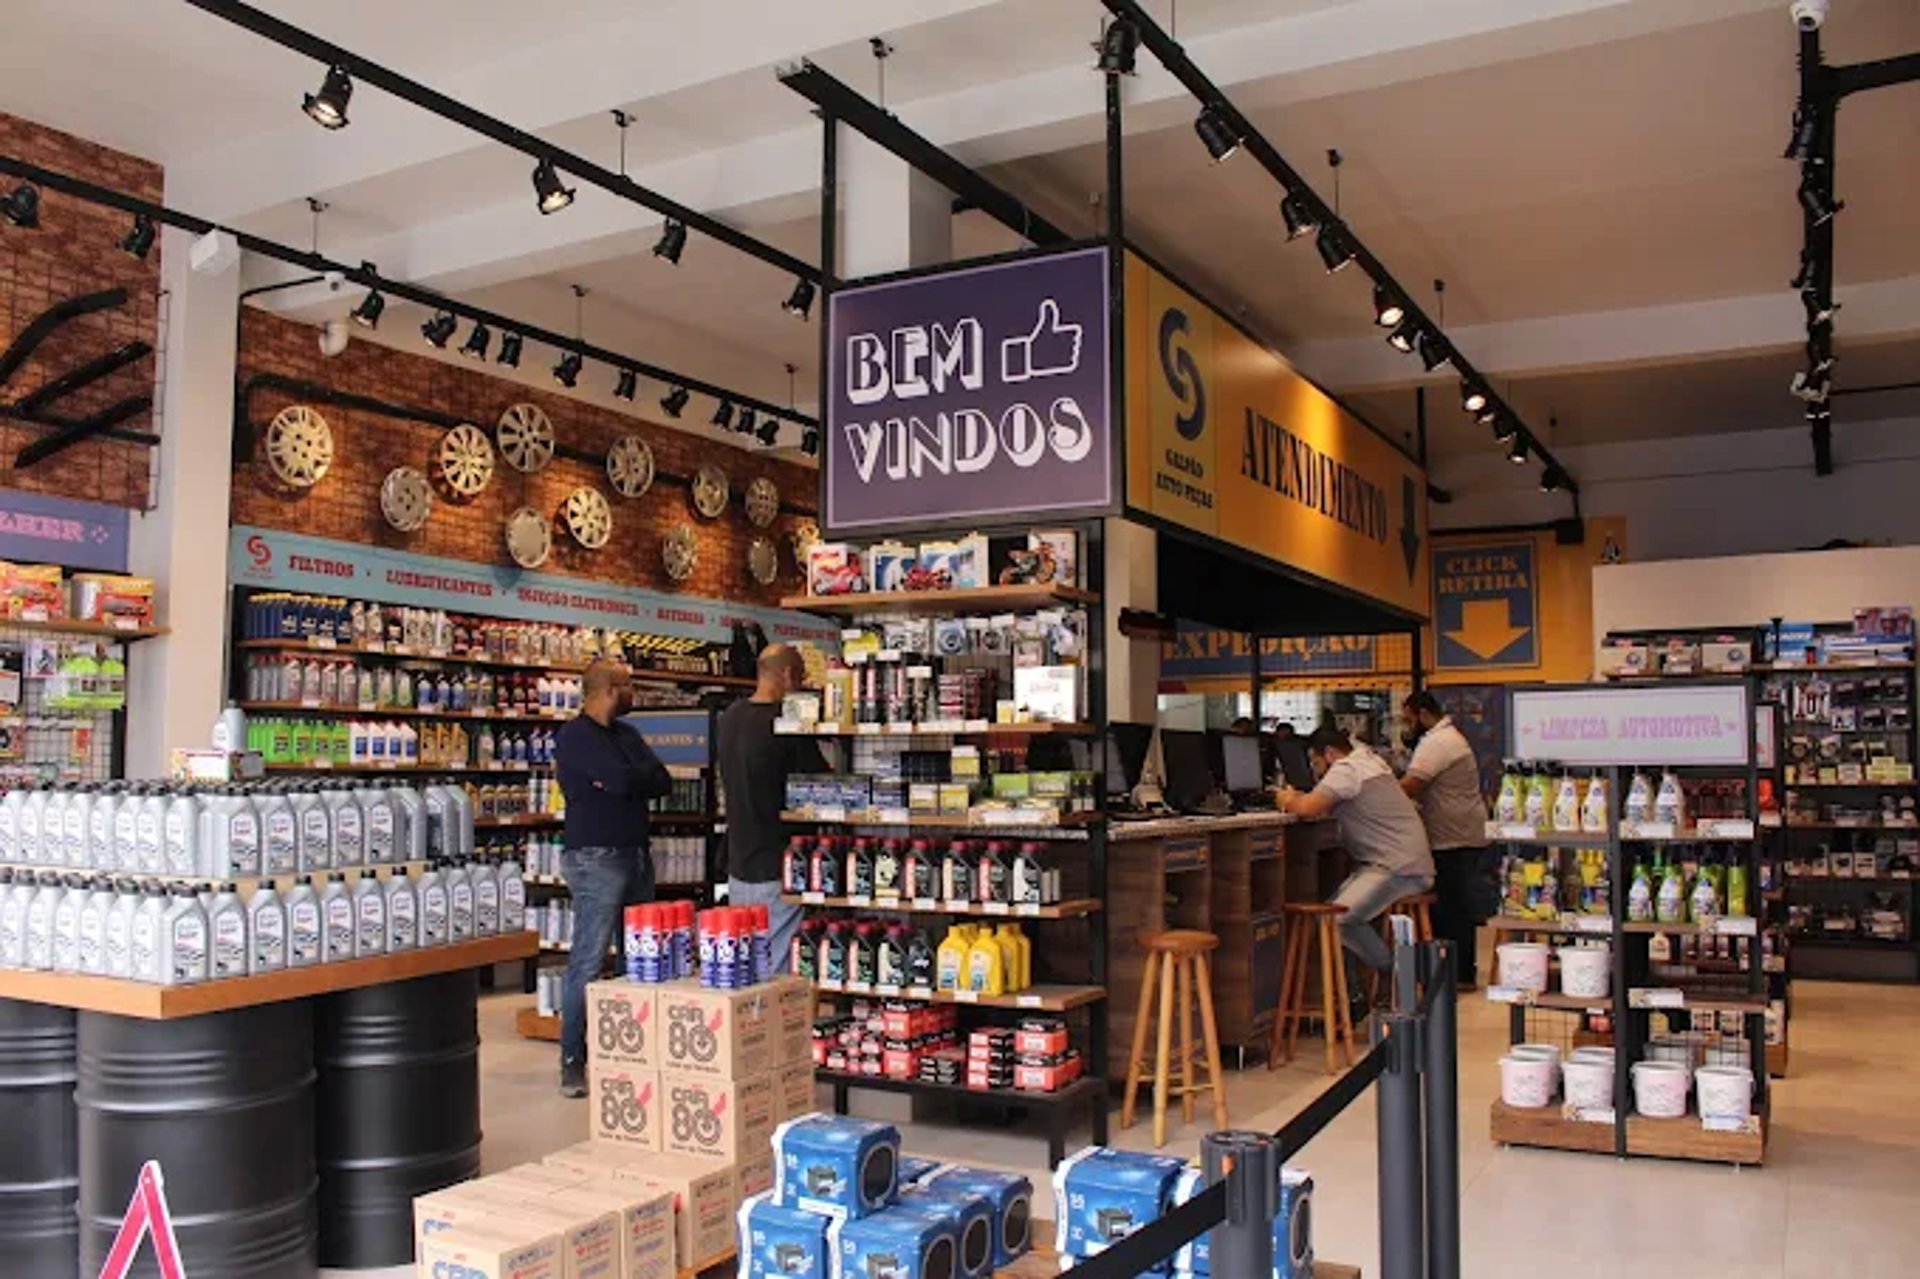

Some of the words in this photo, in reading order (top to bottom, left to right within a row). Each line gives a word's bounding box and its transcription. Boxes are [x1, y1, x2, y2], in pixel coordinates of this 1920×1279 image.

[847, 317, 984, 406] BEM
[844, 397, 1093, 484] VINDOS
[1240, 405, 1389, 546] ATENDIMENTO
[289, 555, 354, 578] FILTROS
[385, 569, 493, 597] LUBRIFICANTES
[1439, 573, 1528, 595] RETIRA
[1445, 556, 1519, 575] CLICK
[1539, 715, 1609, 741] LIMPEZA
[1617, 714, 1722, 739] AUTOMOTIVA
[598, 1014, 645, 1054] 80
[668, 1021, 718, 1062] 80
[601, 1095, 648, 1135] 80
[671, 1103, 722, 1147] 80
